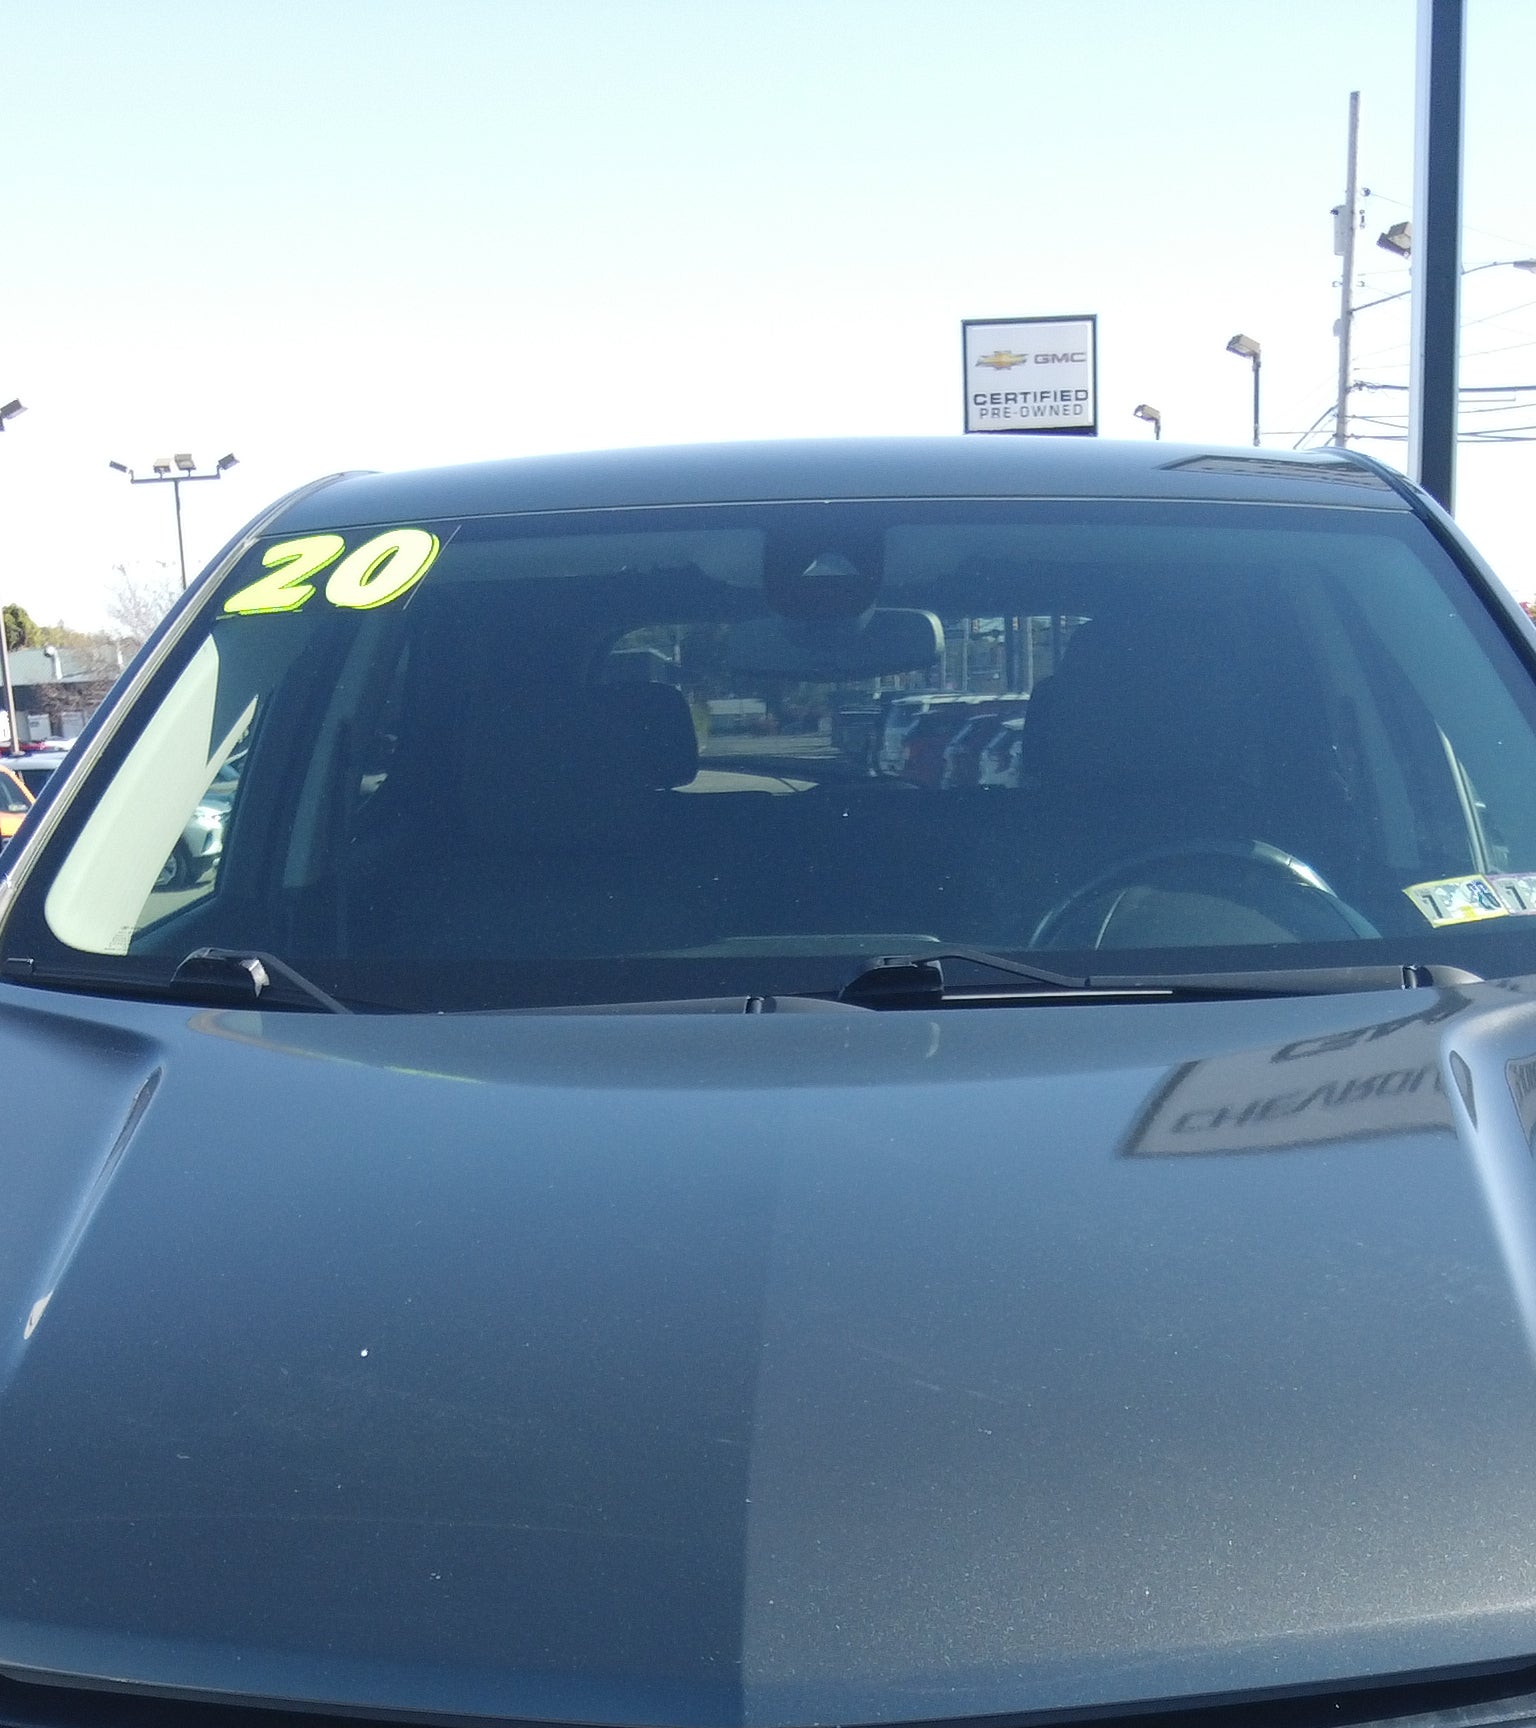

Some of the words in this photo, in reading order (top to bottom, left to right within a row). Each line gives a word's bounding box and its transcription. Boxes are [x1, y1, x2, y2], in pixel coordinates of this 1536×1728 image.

[1033, 352, 1087, 365] GMC
[973, 389, 1089, 406] CERTIFIED
[979, 404, 1084, 420] PRE-OWNED
[223, 528, 440, 616] 20
